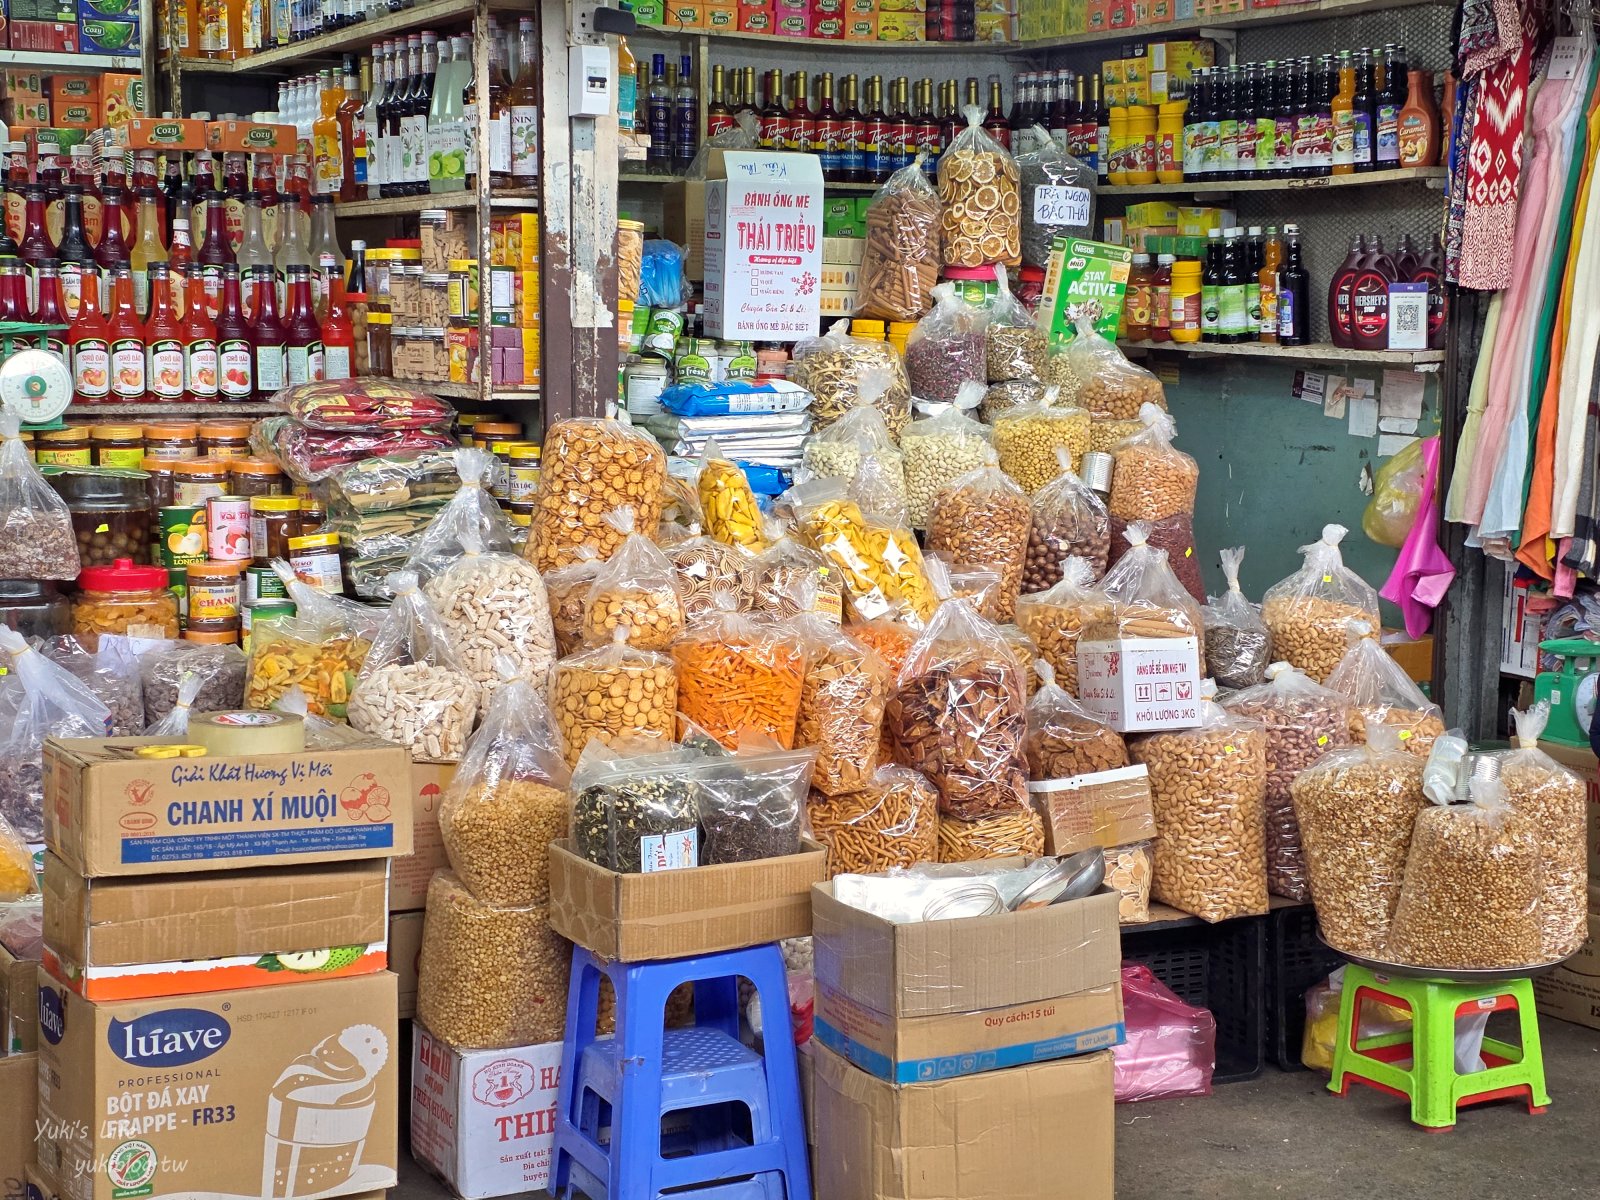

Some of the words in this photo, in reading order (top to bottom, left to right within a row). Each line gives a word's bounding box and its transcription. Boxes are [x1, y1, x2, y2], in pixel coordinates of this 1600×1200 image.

[680, 9, 694, 17] Cozy
[84, 26, 103, 34] Cozy
[68, 109, 87, 118] Cozy
[156, 125, 178, 135] Cozy
[251, 129, 271, 140] Cozy
[765, 123, 790, 140] Torani
[791, 126, 815, 142] Torani
[817, 126, 841, 142] Toran
[841, 123, 865, 141] Torani
[1400, 124, 1426, 136] Caramel
[37, 133, 56, 142] Cozy
[915, 130, 939, 144] Torani
[744, 191, 770, 207] BÁNH
[773, 189, 793, 208] ỐNG
[1039, 186, 1060, 200] TRÀ
[1065, 190, 1090, 202] NGON
[1066, 203, 1088, 221] THÁI
[736, 215, 771, 251] THÁI
[1074, 244, 1095, 255] Nestlé
[1069, 260, 1084, 268] MILO
[1084, 271, 1106, 281] STAY
[1068, 280, 1117, 297] ACTIVE
[1355, 295, 1387, 307] HERSHEY'S
[737, 320, 755, 330] BÁNH
[756, 320, 769, 330] ỐNG
[686, 367, 706, 377] fresh
[740, 367, 755, 377] fres
[173, 557, 205, 565] LONGAN
[200, 596, 237, 607] CHANH
[1155, 709, 1179, 723] LƯỢNG
[171, 765, 205, 788] Giải
[245, 763, 288, 786] Hương
[291, 761, 305, 783] Vị
[308, 761, 334, 778] Mới
[167, 799, 244, 826] CHANH
[251, 791, 274, 822] XÍ
[281, 788, 338, 823] MUỘI
[177, 836, 195, 844] CÔNG
[984, 1016, 1004, 1027] Quy
[1005, 1008, 1041, 1024] cách:15
[1043, 1006, 1056, 1017] túi
[118, 1068, 221, 1089] PROFESSIONAL
[107, 1091, 143, 1115] BỘT
[147, 1085, 173, 1109] ĐÁ
[176, 1085, 210, 1106] XAY
[106, 1113, 177, 1138] FRAPPE
[192, 1105, 236, 1126] FR33
